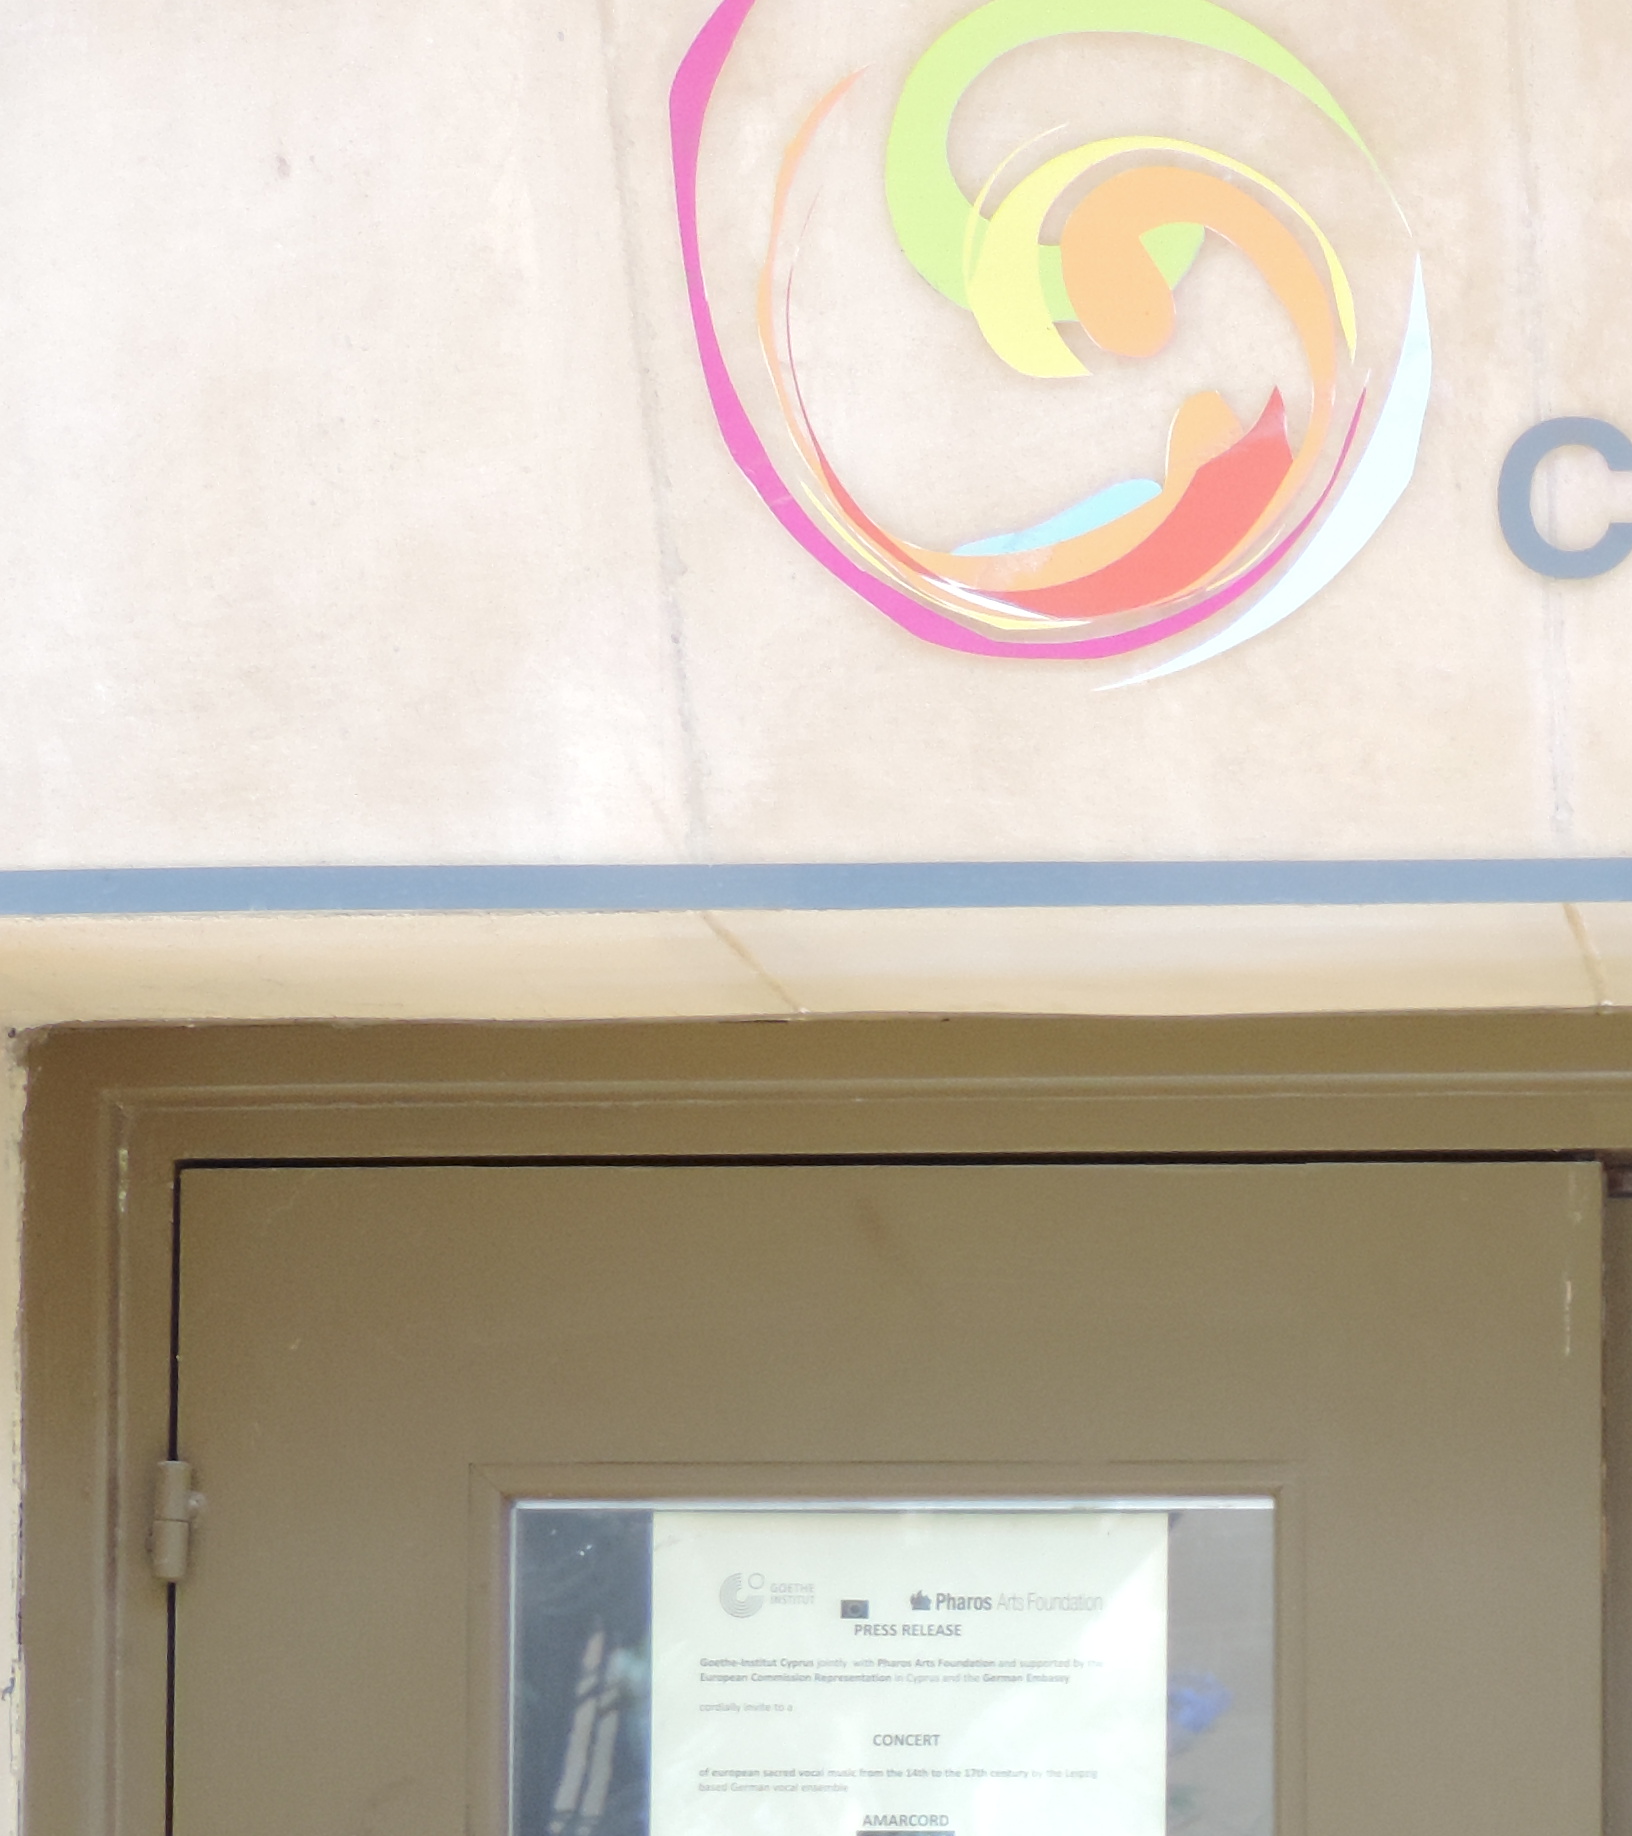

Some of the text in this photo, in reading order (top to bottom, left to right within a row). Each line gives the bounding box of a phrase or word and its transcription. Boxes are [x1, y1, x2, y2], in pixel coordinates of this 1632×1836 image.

[770, 1583, 814, 1592] GOETHE
[770, 1595, 815, 1605] INSTITUT
[935, 1593, 1102, 1610] Pharos Arts Foundation
[854, 1624, 961, 1636] PRESS RELEASE
[700, 1659, 777, 1669] Goethe-Institut
[781, 1659, 814, 1669] Cyprus
[878, 1659, 912, 1669] Pharos
[915, 1659, 935, 1669] Arts
[938, 1659, 995, 1669] Foundation
[700, 1673, 748, 1683] European
[751, 1673, 810, 1683] Commission
[814, 1673, 891, 1683] Representation
[983, 1673, 1022, 1683] German
[1026, 1673, 1070, 1683] Embassy
[873, 1734, 940, 1746] CONCERT
[863, 1815, 949, 1826] AMARCORD
